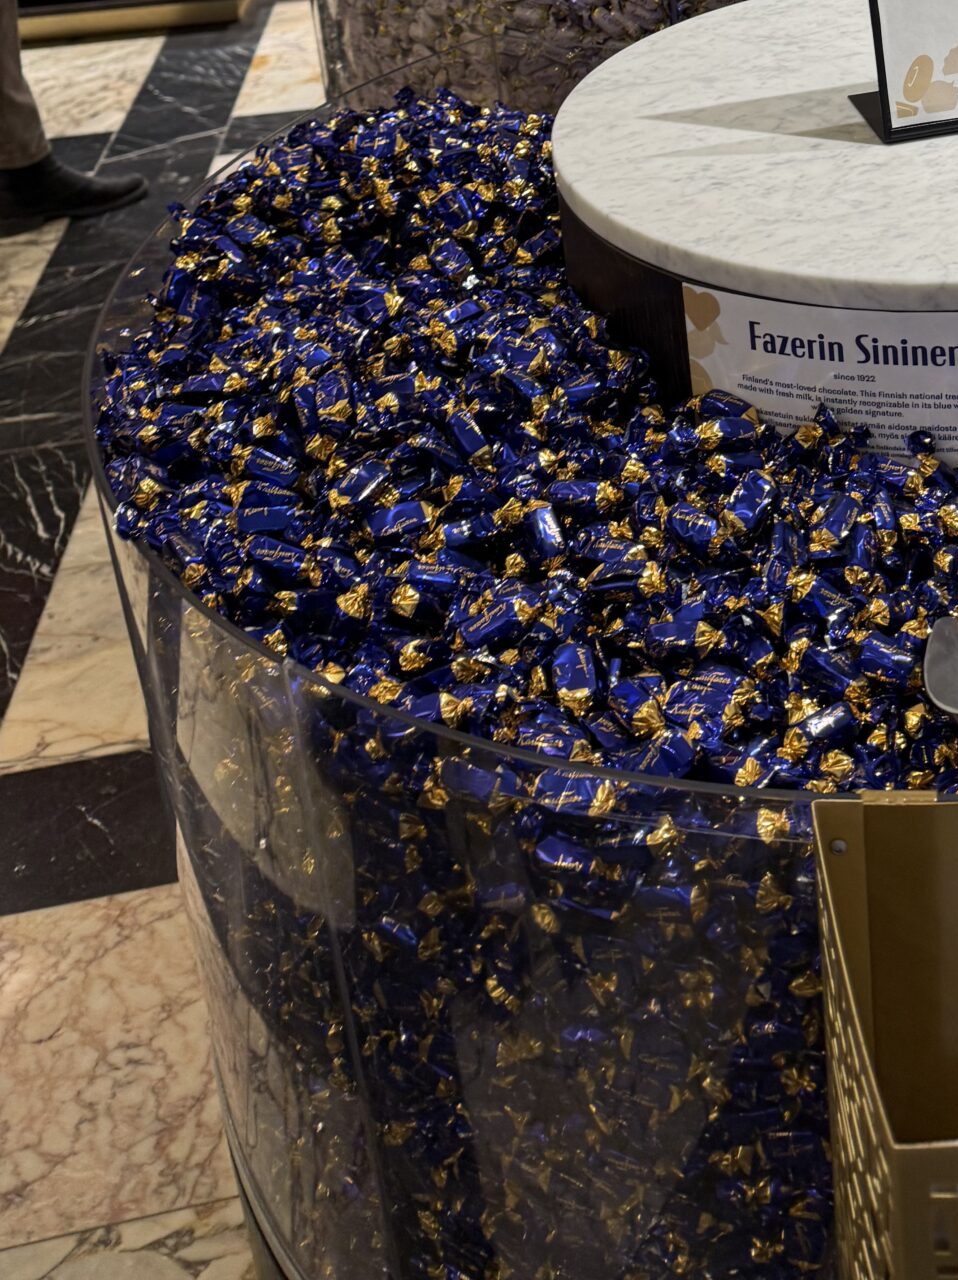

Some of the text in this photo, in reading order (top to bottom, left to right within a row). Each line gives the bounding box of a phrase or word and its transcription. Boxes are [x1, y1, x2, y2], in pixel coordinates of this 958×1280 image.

[748, 320, 845, 362] Fazerin
[833, 372, 876, 383] since 1922
[742, 373, 774, 387] Finland's
[775, 380, 817, 393] most-loved
[818, 386, 859, 397] chocolate.
[860, 390, 877, 398] This
[878, 391, 908, 400] Finnish
[909, 392, 943, 401] national
[737, 382, 758, 392] made
[758, 385, 775, 395] with
[775, 388, 795, 399] fresh
[795, 391, 814, 402] milk,
[822, 395, 858, 407] instantly
[858, 399, 910, 409] recognizable
[836, 405, 863, 416] golden
[865, 408, 904, 419] signature.
[888, 423, 917, 431] aidosta
[920, 423, 957, 432] maidosta
[878, 433, 900, 441] myös
